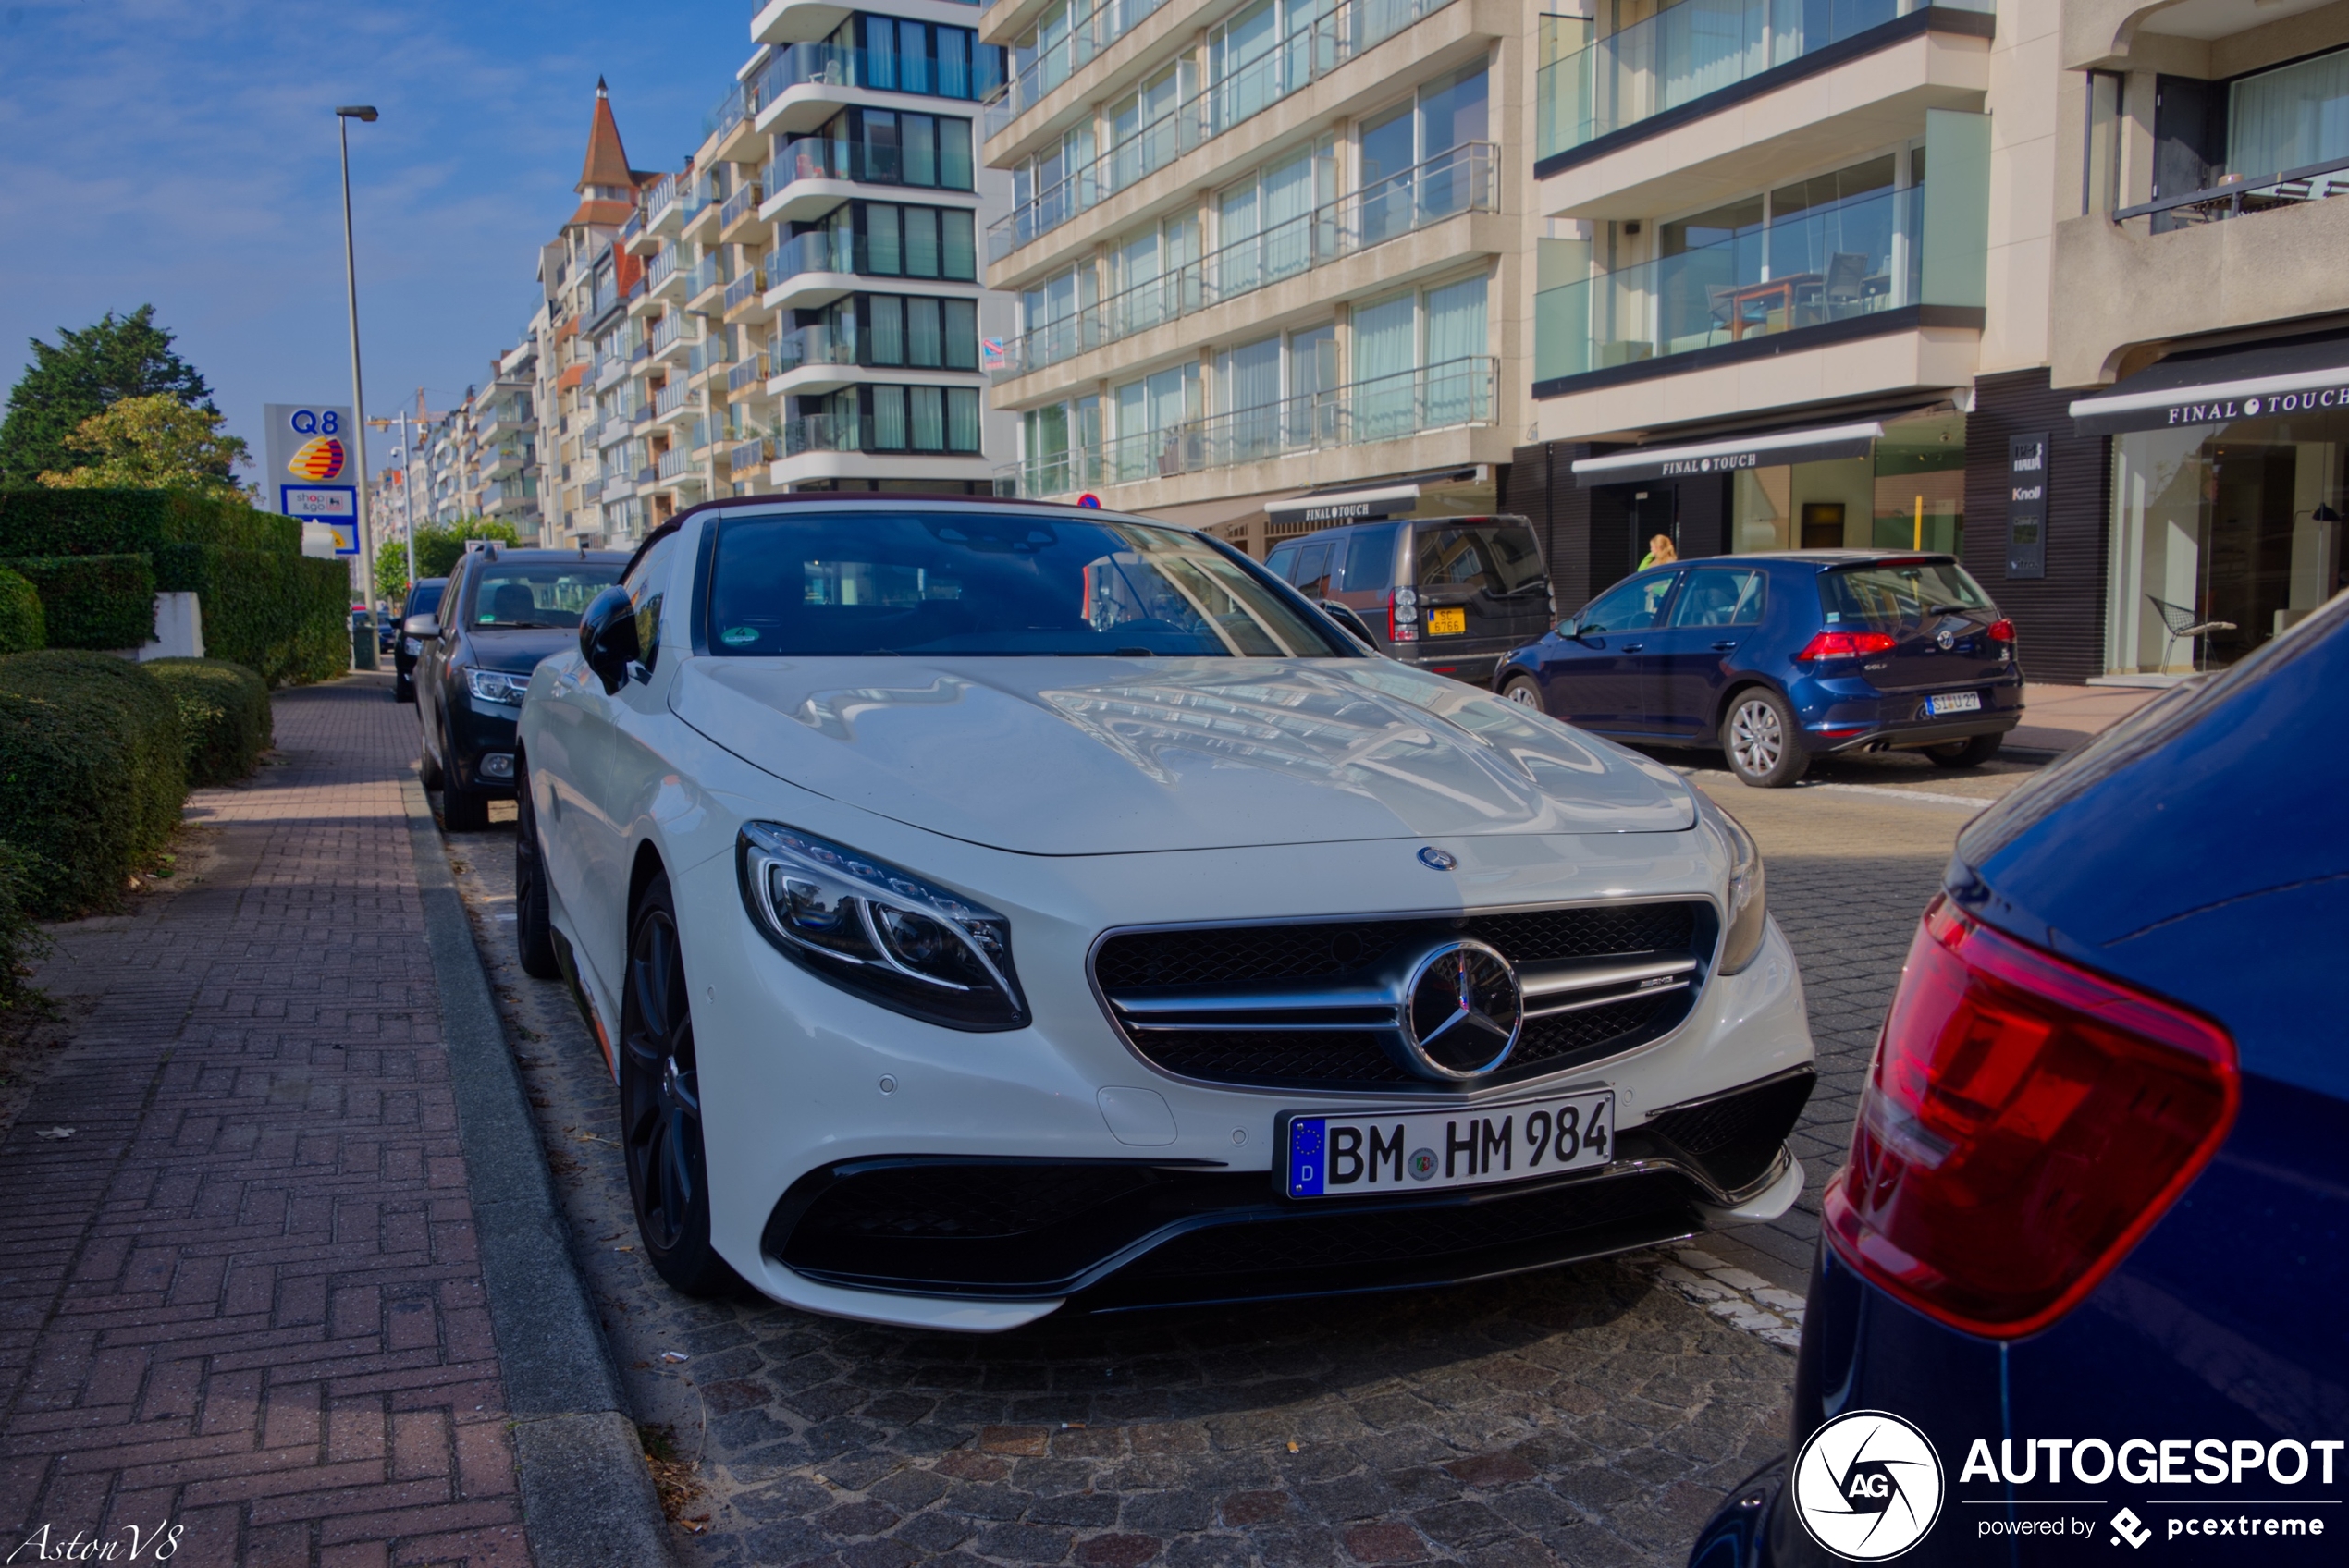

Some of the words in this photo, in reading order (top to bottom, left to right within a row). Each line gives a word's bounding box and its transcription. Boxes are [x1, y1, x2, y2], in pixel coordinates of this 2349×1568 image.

[2168, 402, 2237, 424] FINAL
[2269, 388, 2349, 413] TOUCH
[291, 410, 338, 435] Q8
[1662, 460, 1699, 475] FINAL
[1713, 453, 1756, 470] TOUCH
[297, 493, 325, 504] shop
[2012, 485, 2041, 501] Knoll
[303, 503, 326, 512] &go
[1306, 508, 1331, 521] FINAL
[1339, 504, 1369, 518] TOUCH
[1440, 610, 1453, 620] SC
[1434, 621, 1459, 631] 6766
[1933, 697, 1948, 710] SI
[1955, 696, 1962, 708] U
[1965, 693, 1977, 707] 27
[1301, 1166, 1314, 1182] D
[1328, 1124, 1405, 1185] BM
[1445, 1115, 1513, 1178] HM
[1526, 1101, 1607, 1167] 984
